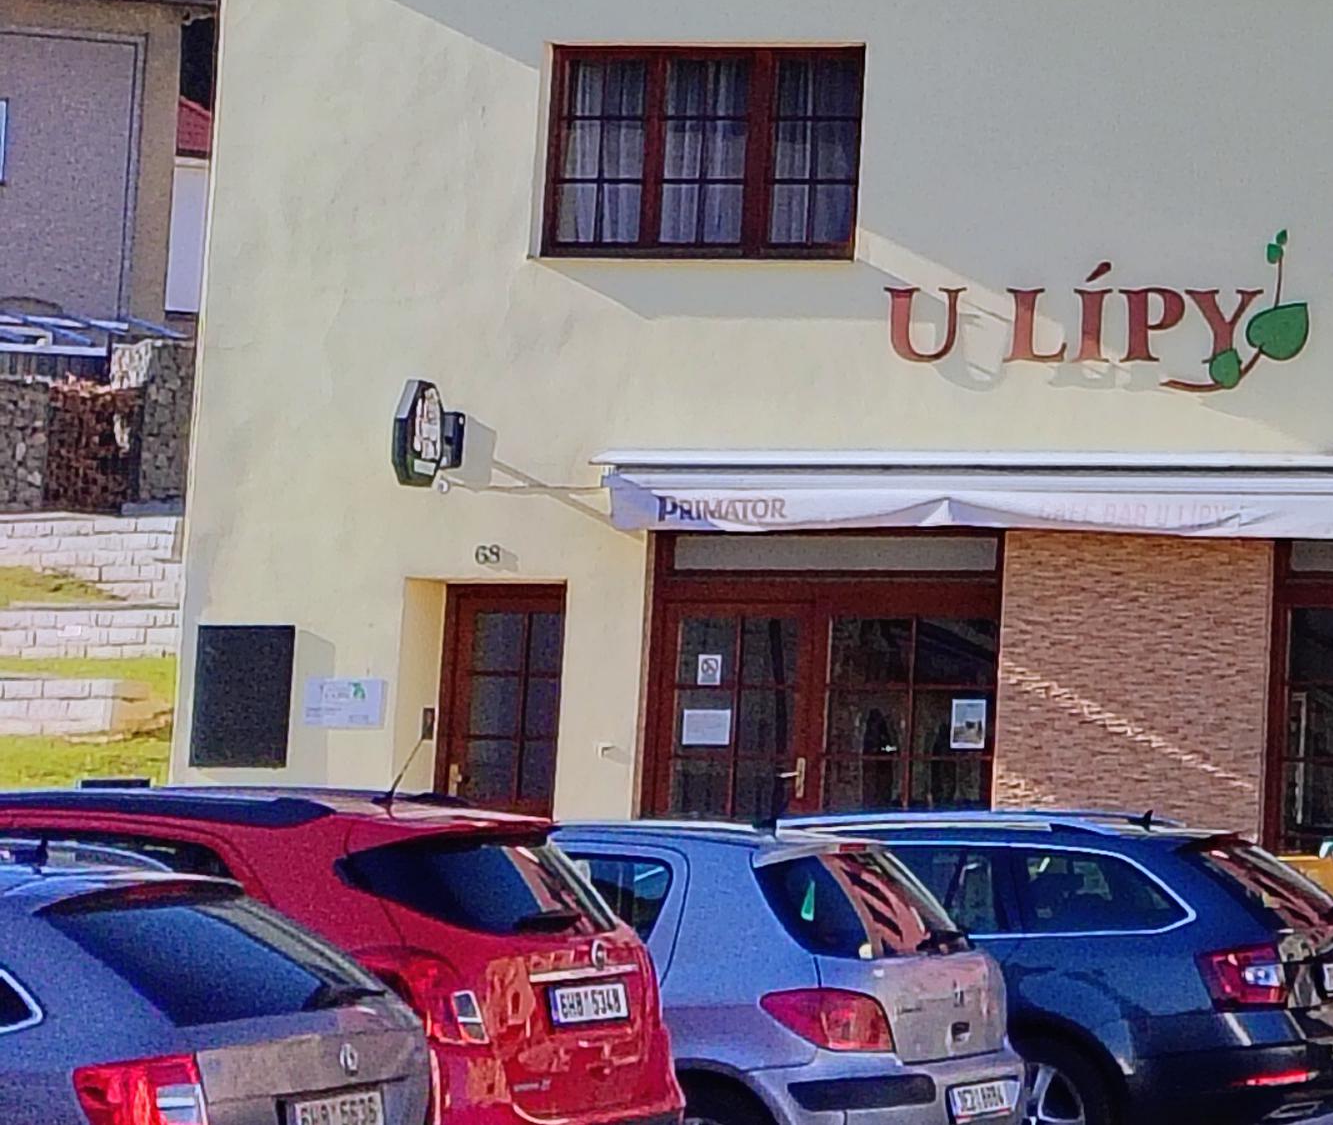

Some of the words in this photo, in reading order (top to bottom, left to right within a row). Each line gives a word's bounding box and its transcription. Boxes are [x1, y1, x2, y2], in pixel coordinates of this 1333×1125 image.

[883, 286, 968, 363] U
[1002, 261, 1265, 364] LÍPY
[657, 495, 788, 522] PRIMATOR
